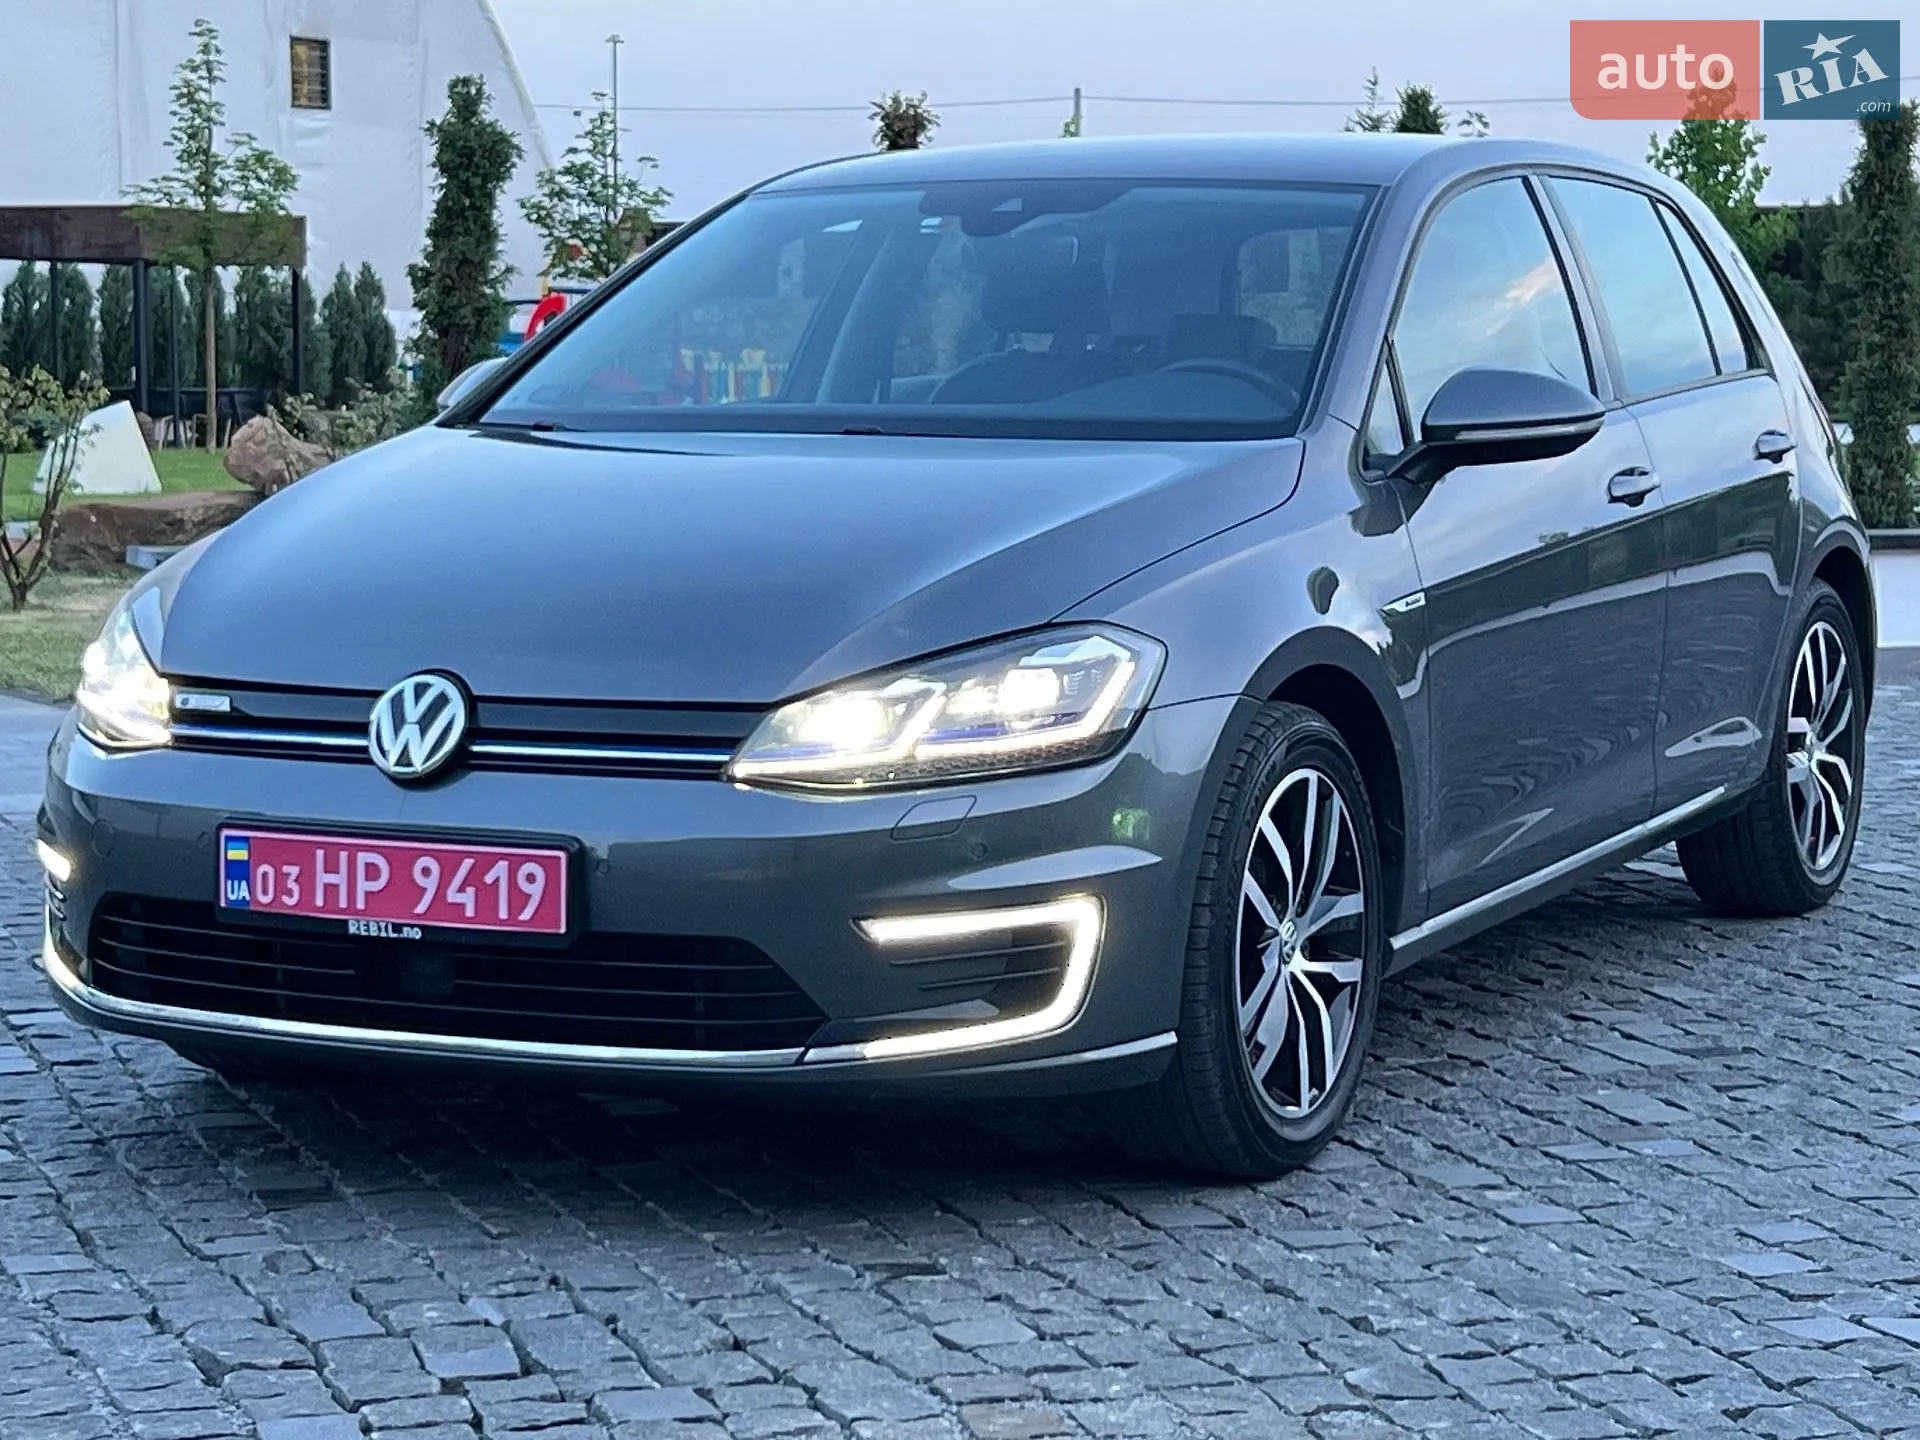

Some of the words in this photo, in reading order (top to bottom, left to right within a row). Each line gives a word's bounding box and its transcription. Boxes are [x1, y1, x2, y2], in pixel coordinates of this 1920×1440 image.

[370, 674, 466, 779] VW
[226, 879, 250, 901] UA
[255, 863, 301, 906] 03
[315, 848, 391, 910] HP
[413, 855, 546, 921] 9419
[348, 919, 422, 940] REBIL.no
